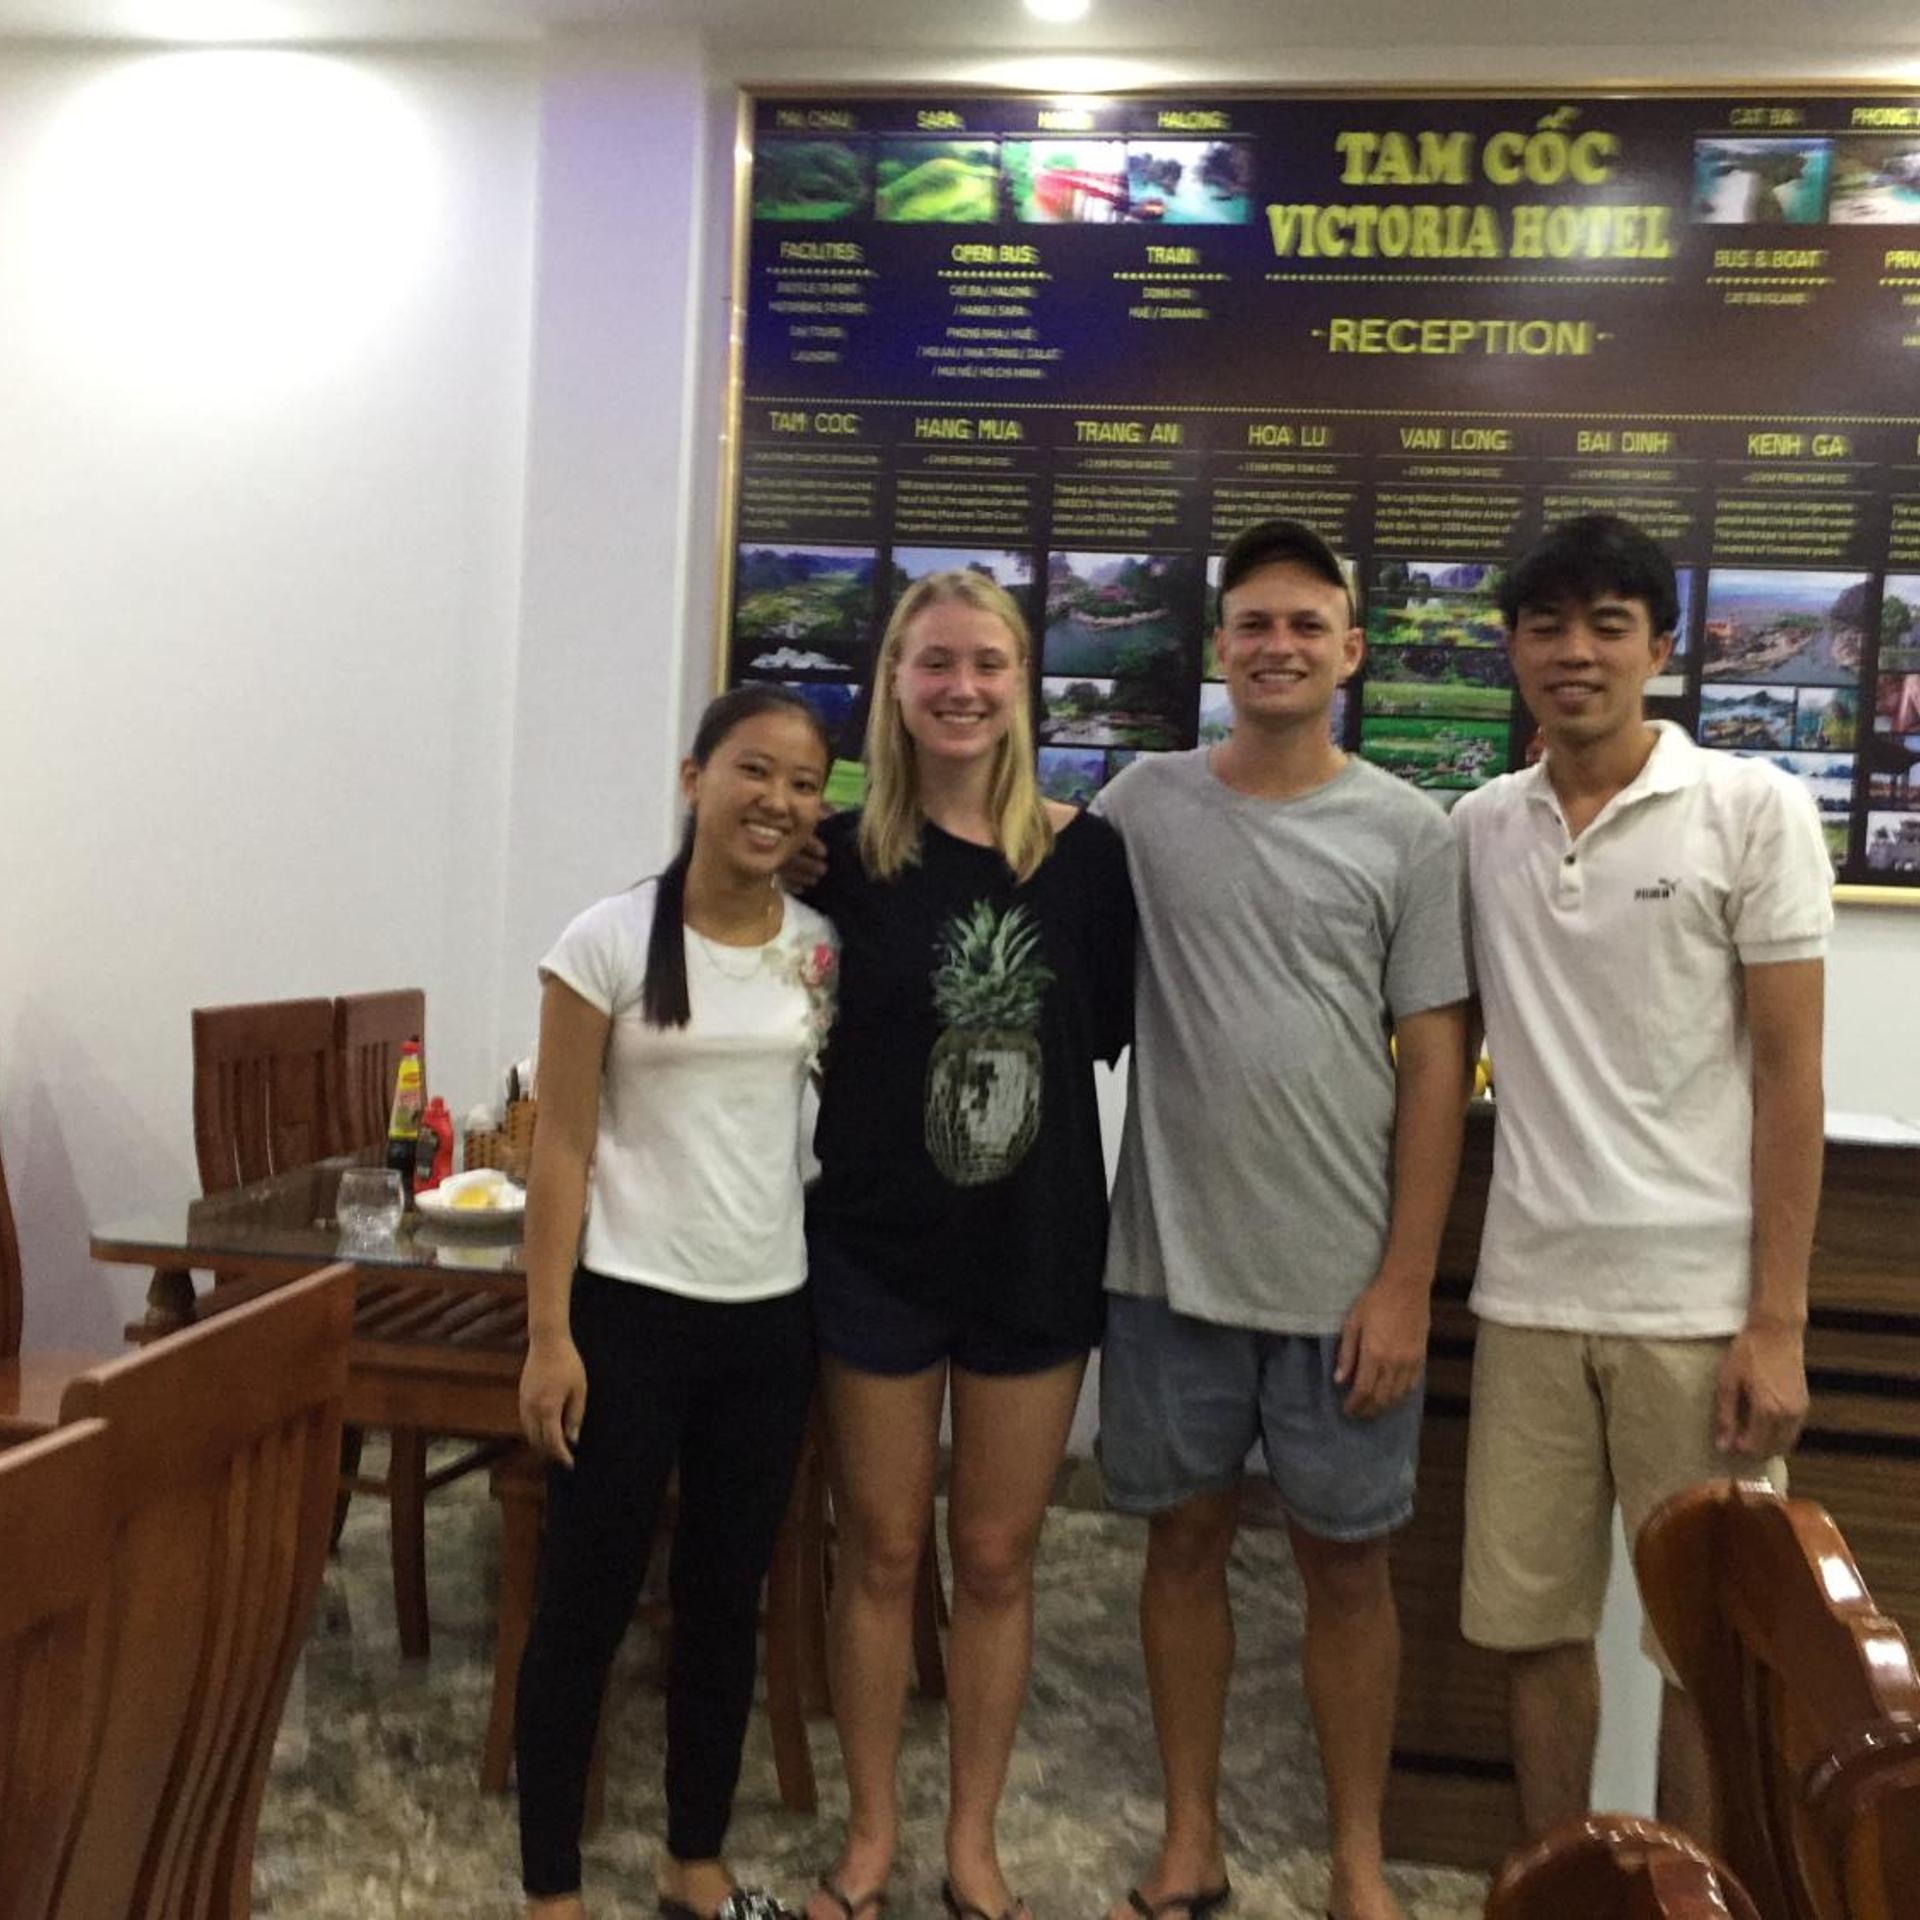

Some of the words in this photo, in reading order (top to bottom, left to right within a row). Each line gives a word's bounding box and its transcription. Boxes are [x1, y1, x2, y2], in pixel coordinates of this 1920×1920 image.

[1336, 132, 1470, 185] TAM
[1265, 205, 1500, 259] VICTORIA
[1510, 205, 1673, 259] HOTEL
[951, 245, 995, 264] OPEN
[1000, 245, 1038, 264] BUS
[1146, 246, 1197, 265] TRAIN
[1714, 250, 1750, 268] BUS
[1771, 251, 1820, 268] BOAT
[769, 411, 806, 431] TAM
[814, 413, 858, 434] COC
[915, 417, 970, 439] HANG
[978, 419, 1020, 440] MUA
[1075, 421, 1141, 443] TRANG
[1149, 423, 1179, 444] AN
[1249, 424, 1290, 446] HOA
[1301, 426, 1328, 446] LU
[1400, 428, 1440, 450] VAN
[1451, 429, 1508, 450] LONG
[1577, 431, 1611, 452] BAI
[1621, 431, 1669, 453] DINH
[1748, 433, 1800, 455] KENH
[1812, 434, 1846, 456] GA
